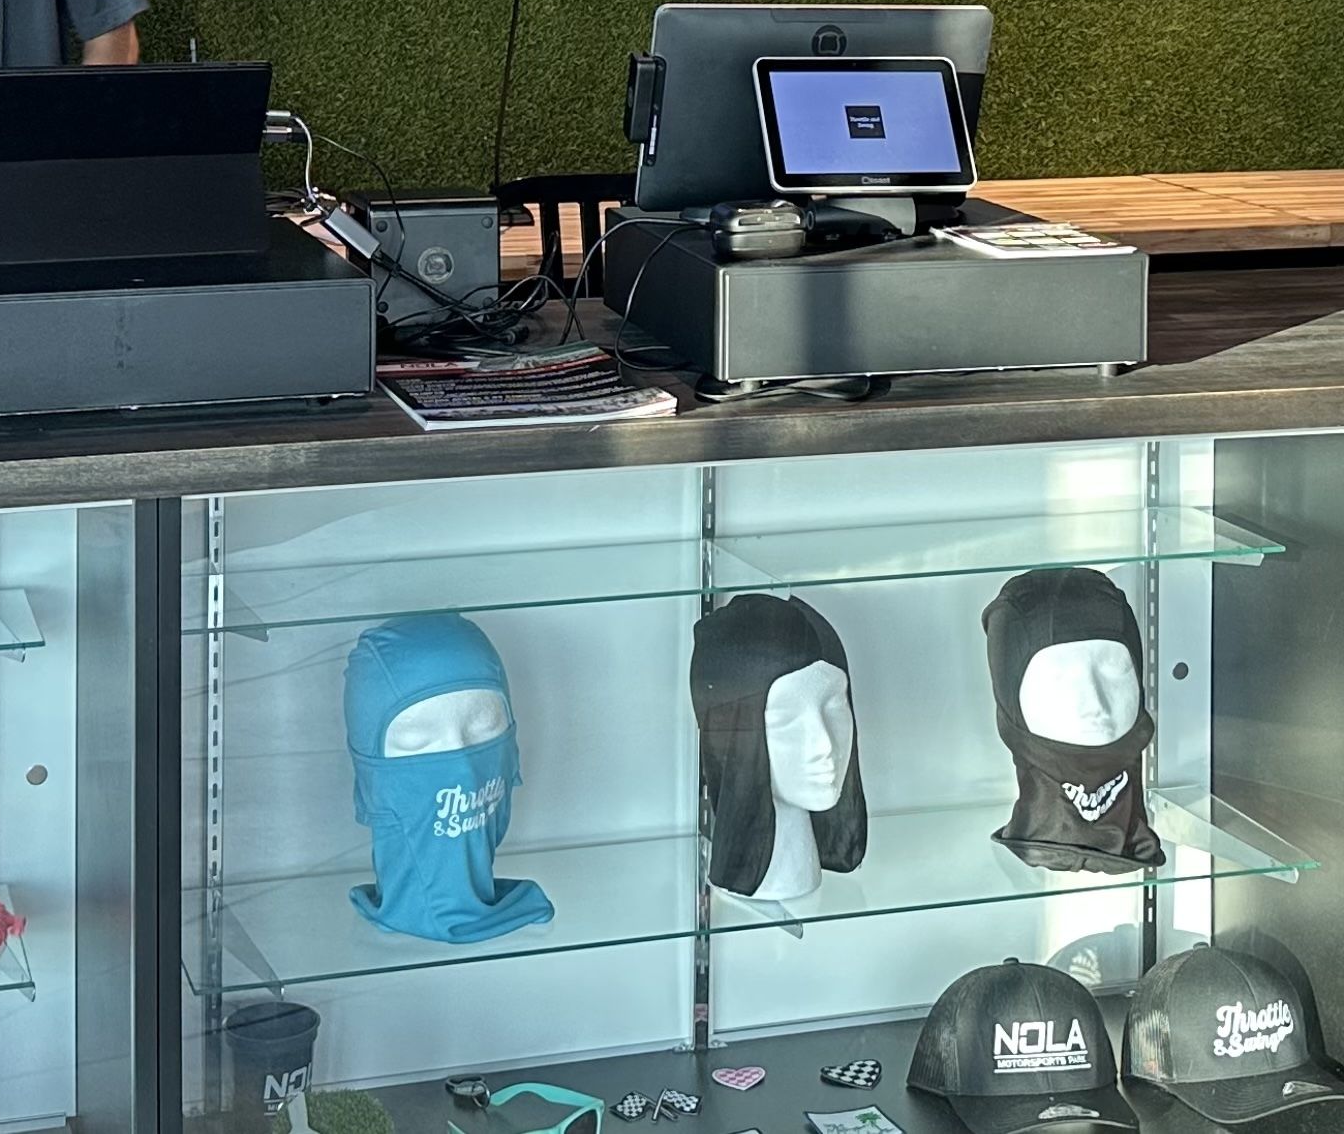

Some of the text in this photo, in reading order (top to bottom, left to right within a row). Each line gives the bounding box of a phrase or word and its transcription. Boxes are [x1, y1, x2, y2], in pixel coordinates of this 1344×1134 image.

[1216, 999, 1294, 1037] Throttle
[994, 1019, 1087, 1055] NOLA
[997, 1057, 1065, 1069] MOTORSPORTS
